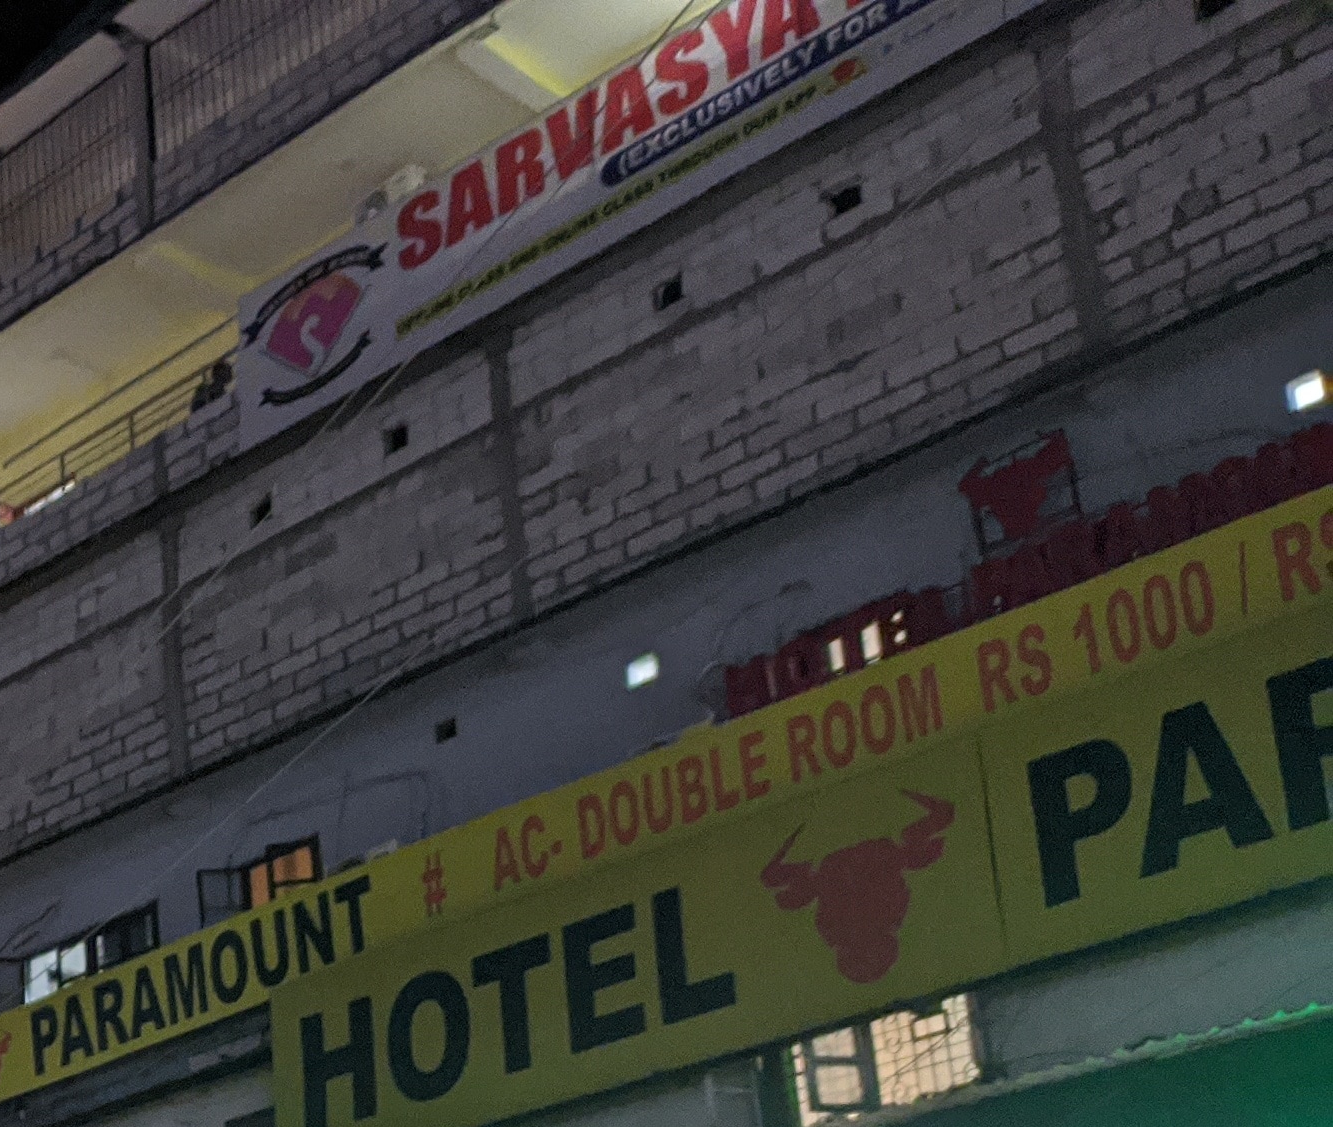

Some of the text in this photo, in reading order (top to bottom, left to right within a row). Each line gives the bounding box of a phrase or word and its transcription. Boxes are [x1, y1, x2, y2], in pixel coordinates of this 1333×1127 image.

[397, 0, 822, 270] SARVASYA
[619, 42, 815, 176] (EXCLUSIVELY
[826, 3, 888, 53] FOR
[578, 730, 771, 861] DOUBLE
[786, 664, 943, 786] ROOM
[977, 623, 1052, 714] RS
[1072, 559, 1216, 674] 1000
[31, 874, 371, 1074] PARAMOUNT
